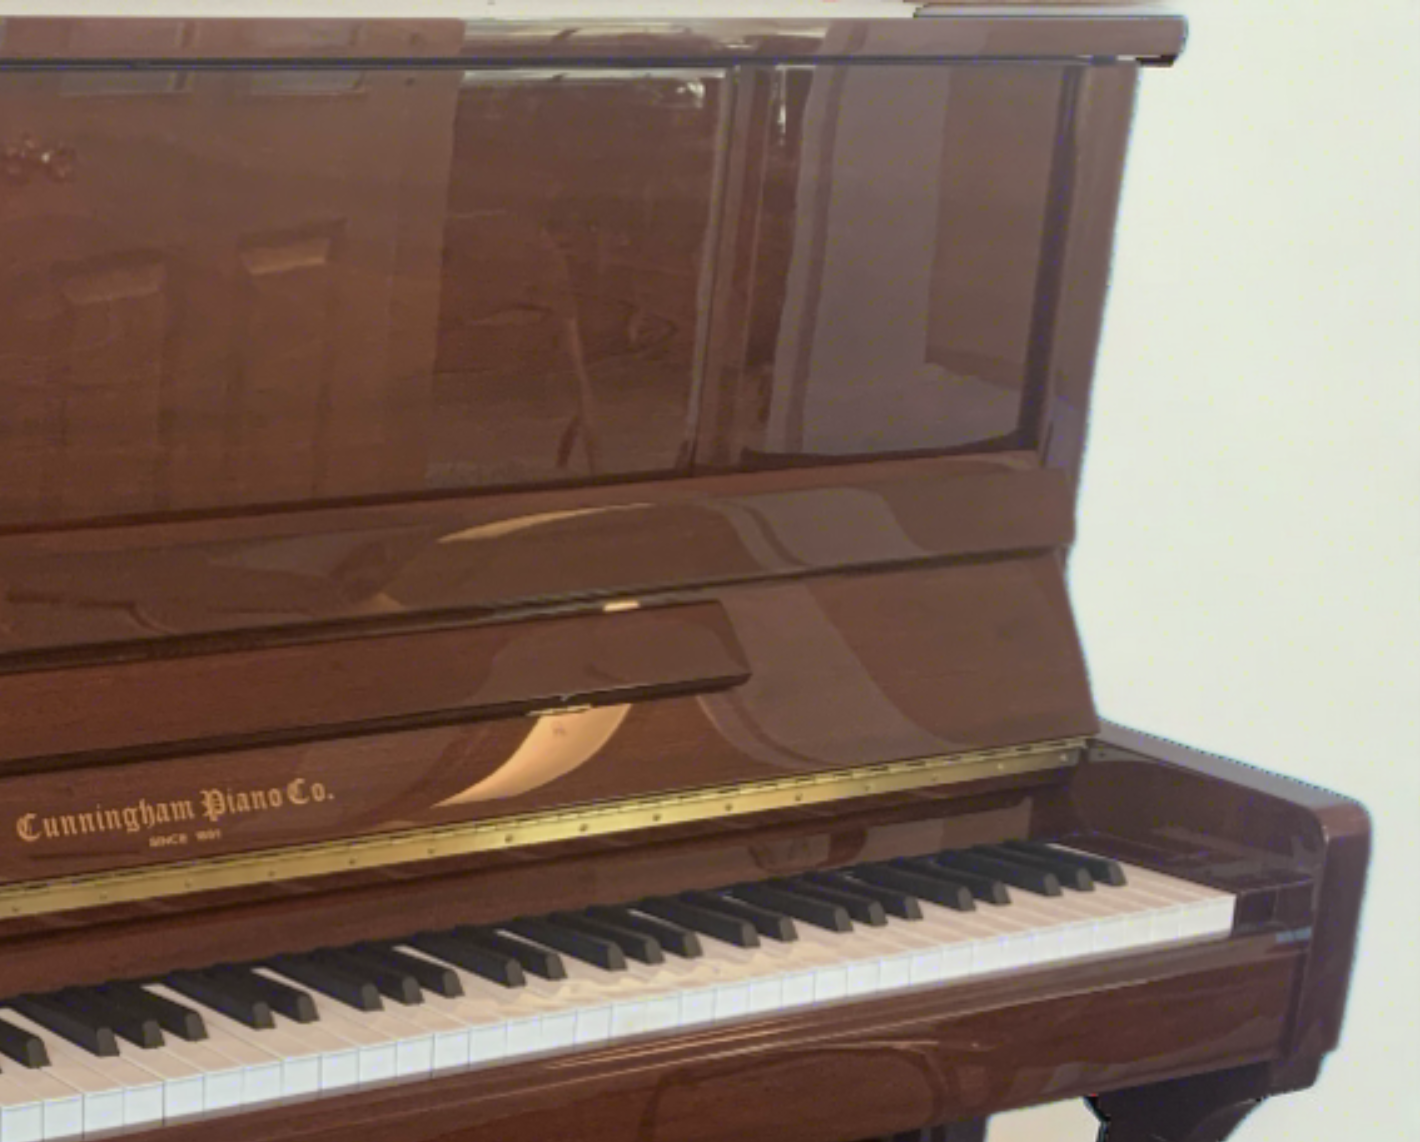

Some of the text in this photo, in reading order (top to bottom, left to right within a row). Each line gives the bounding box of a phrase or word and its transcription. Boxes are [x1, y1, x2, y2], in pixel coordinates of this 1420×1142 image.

[16, 778, 334, 841] Cunningham Piano Co.
